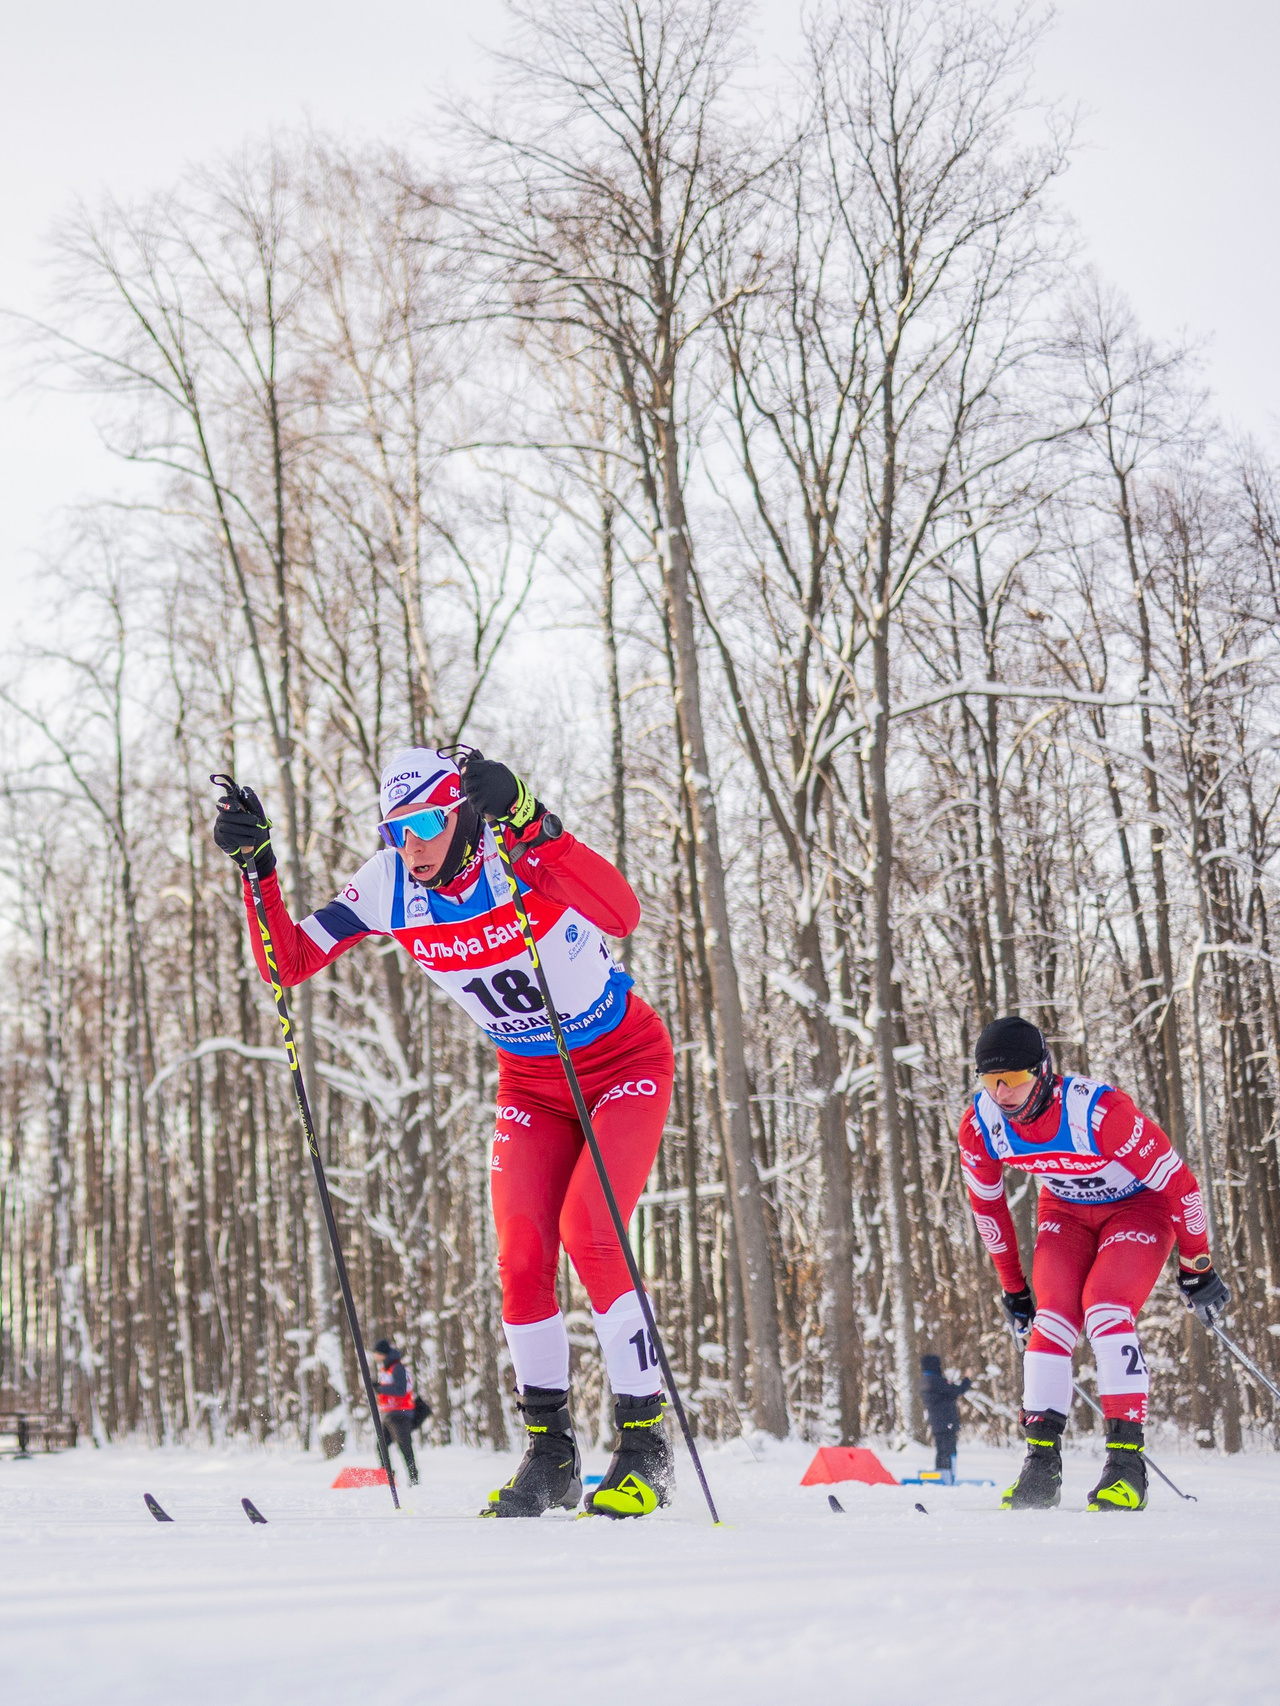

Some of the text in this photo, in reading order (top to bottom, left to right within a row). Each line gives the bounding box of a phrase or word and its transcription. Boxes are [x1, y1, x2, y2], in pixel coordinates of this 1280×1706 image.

[384, 771, 422, 790] LUKOIL
[413, 912, 540, 962] Альфа Банк
[462, 968, 545, 1018] 18
[561, 990, 615, 1034] ТАТАРСТАН
[495, 1105, 532, 1128] KOIL
[1113, 1115, 1144, 1158] LUKOIL
[1013, 1158, 1060, 1172] льфа
